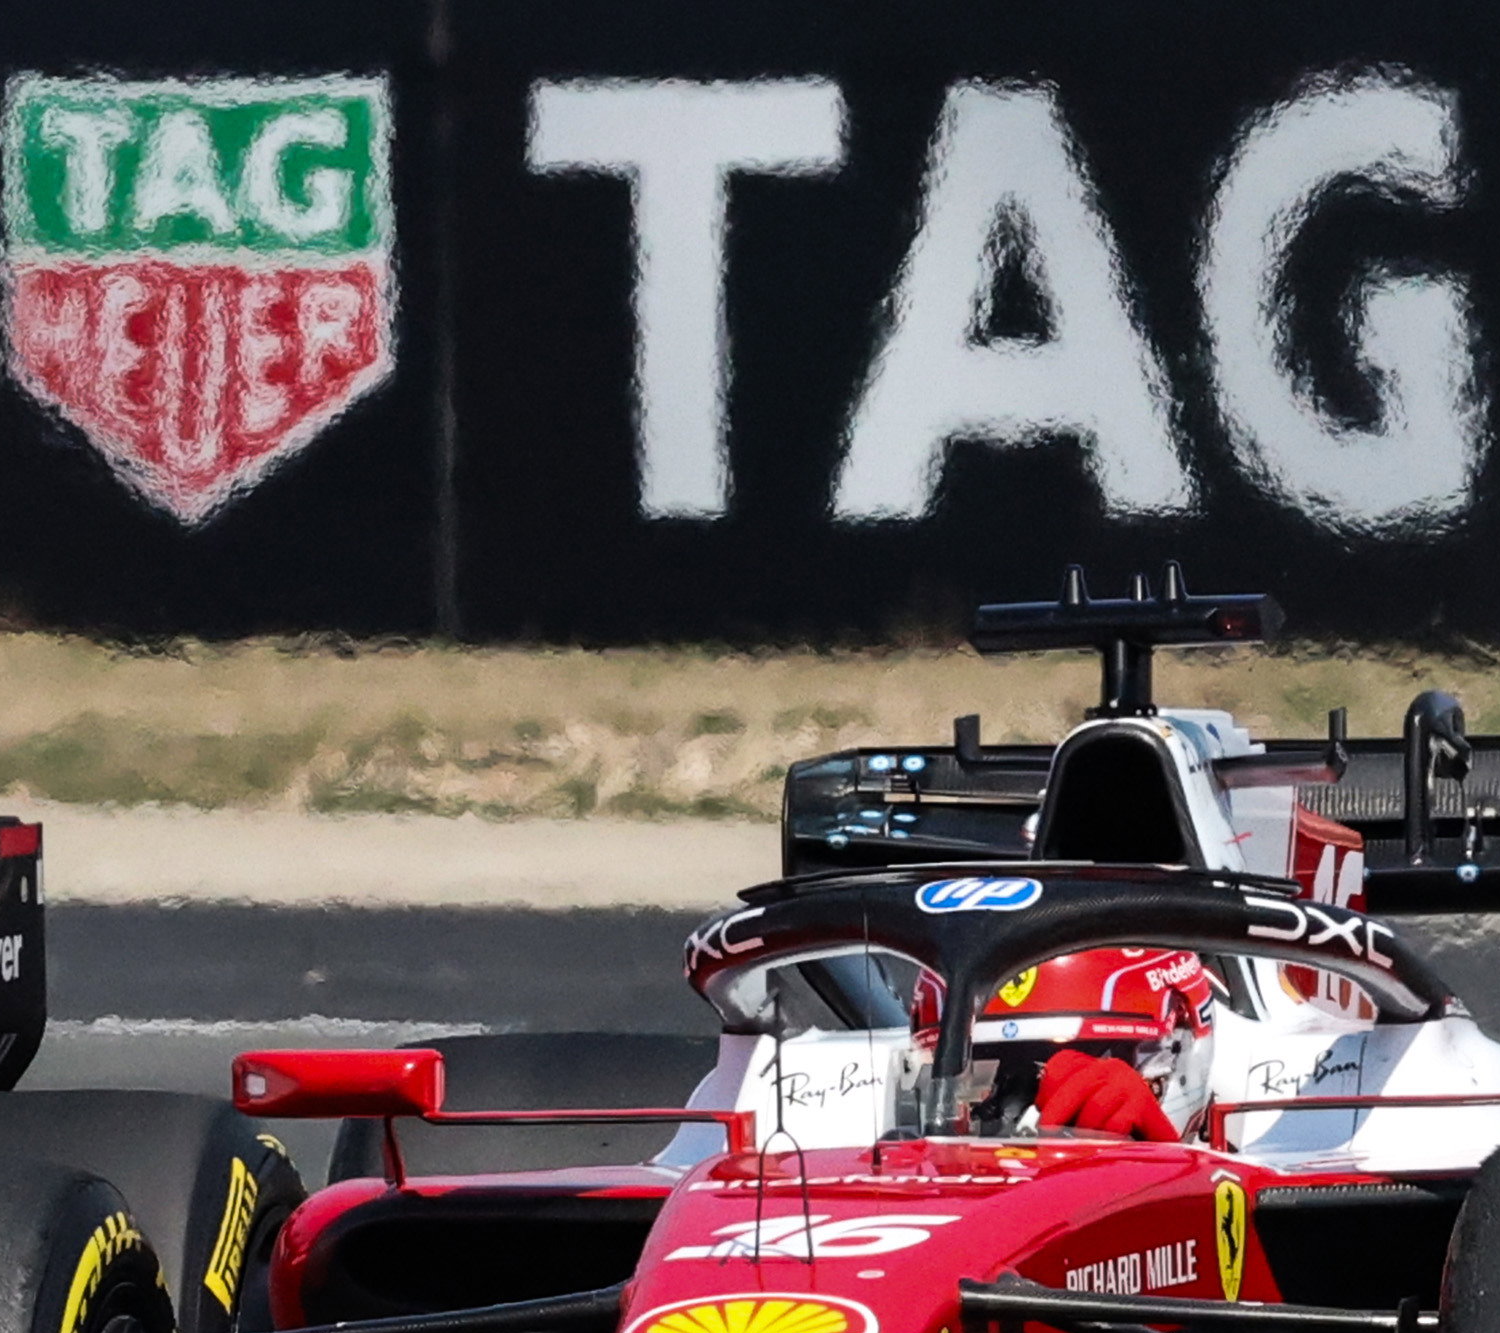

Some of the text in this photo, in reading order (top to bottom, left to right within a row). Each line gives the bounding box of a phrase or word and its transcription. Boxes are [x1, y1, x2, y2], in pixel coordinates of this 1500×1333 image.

[40, 100, 352, 238] TAG
[18, 258, 388, 465] HEUER
[918, 877, 1040, 912] hp
[1244, 896, 1395, 970] DXC
[771, 1062, 884, 1108] Ray-Ban
[1248, 1050, 1359, 1095] Ray-Ban
[663, 1214, 963, 1262] 16
[1066, 1239, 1197, 1295] RICHARD MILLE
